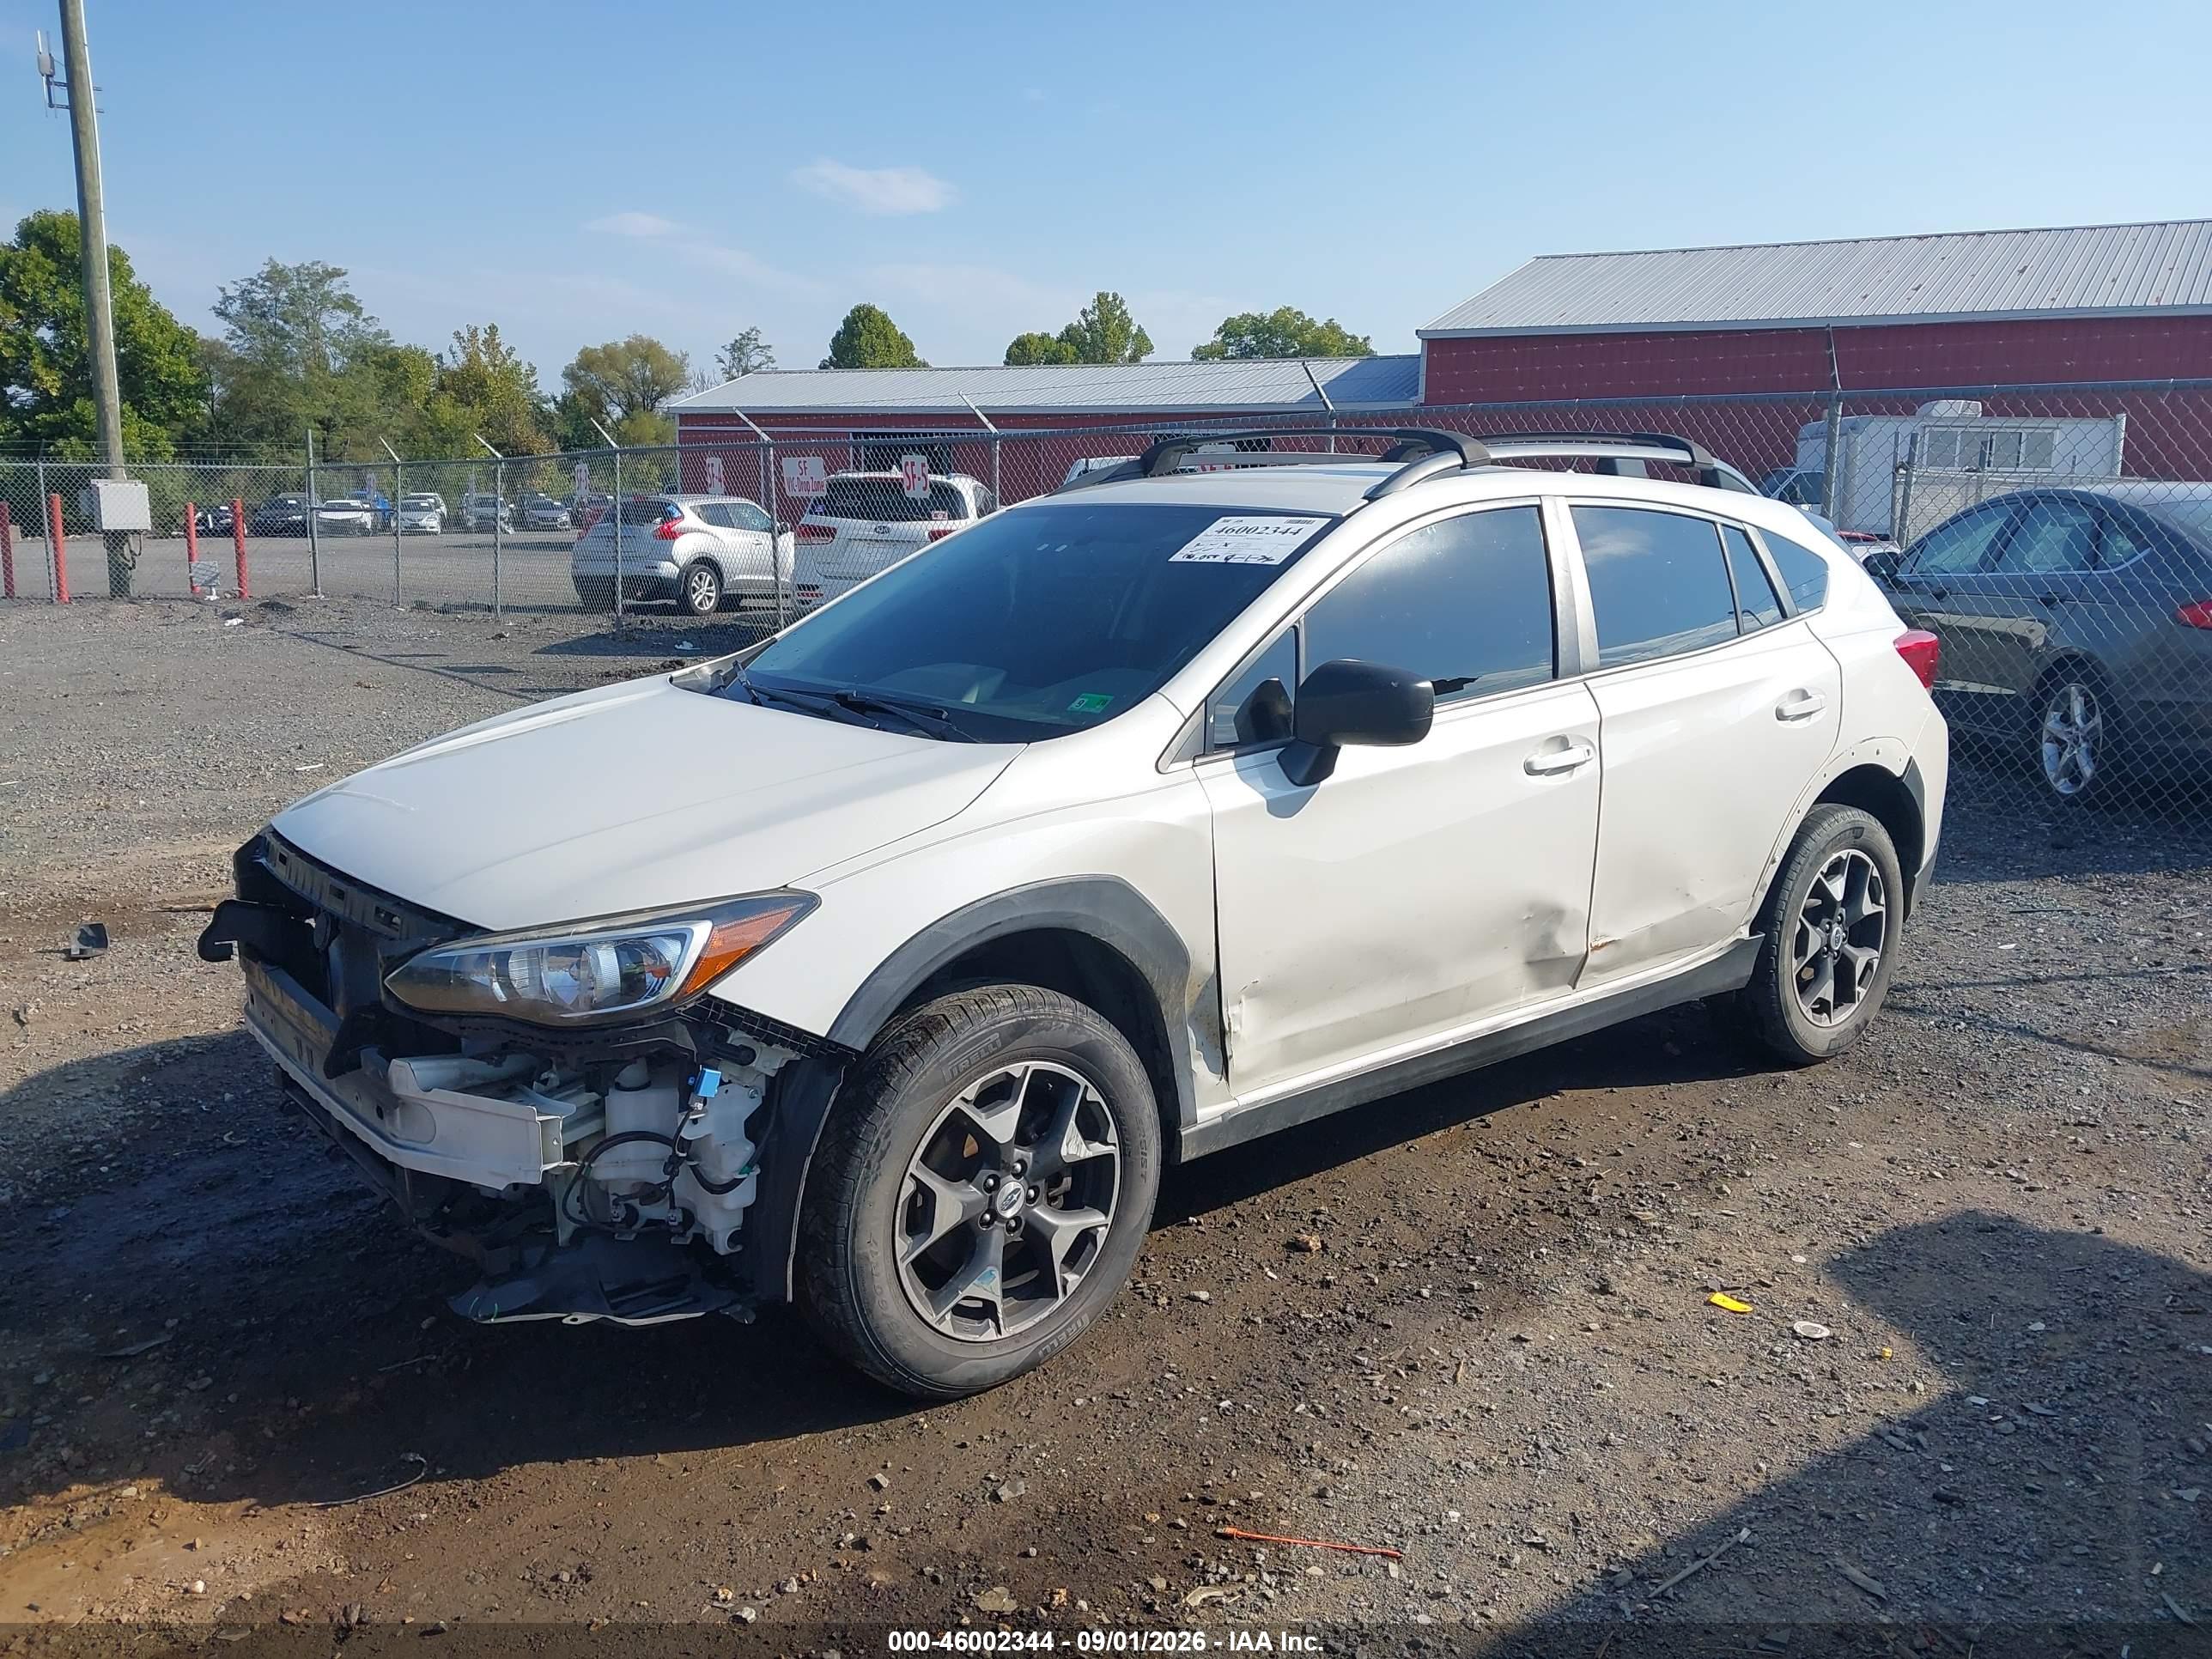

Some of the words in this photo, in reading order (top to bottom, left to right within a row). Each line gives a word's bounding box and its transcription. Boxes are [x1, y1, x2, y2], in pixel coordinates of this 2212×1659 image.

[708, 462, 722, 488] SF-4
[798, 460, 808, 476] SF
[904, 461, 927, 491] SF-5
[811, 477, 824, 492] Zone
[1214, 526, 1304, 536] 46002344
[941, 1033, 1002, 1083] PIRELLI
[1037, 1313, 1091, 1362] PIRELLI
